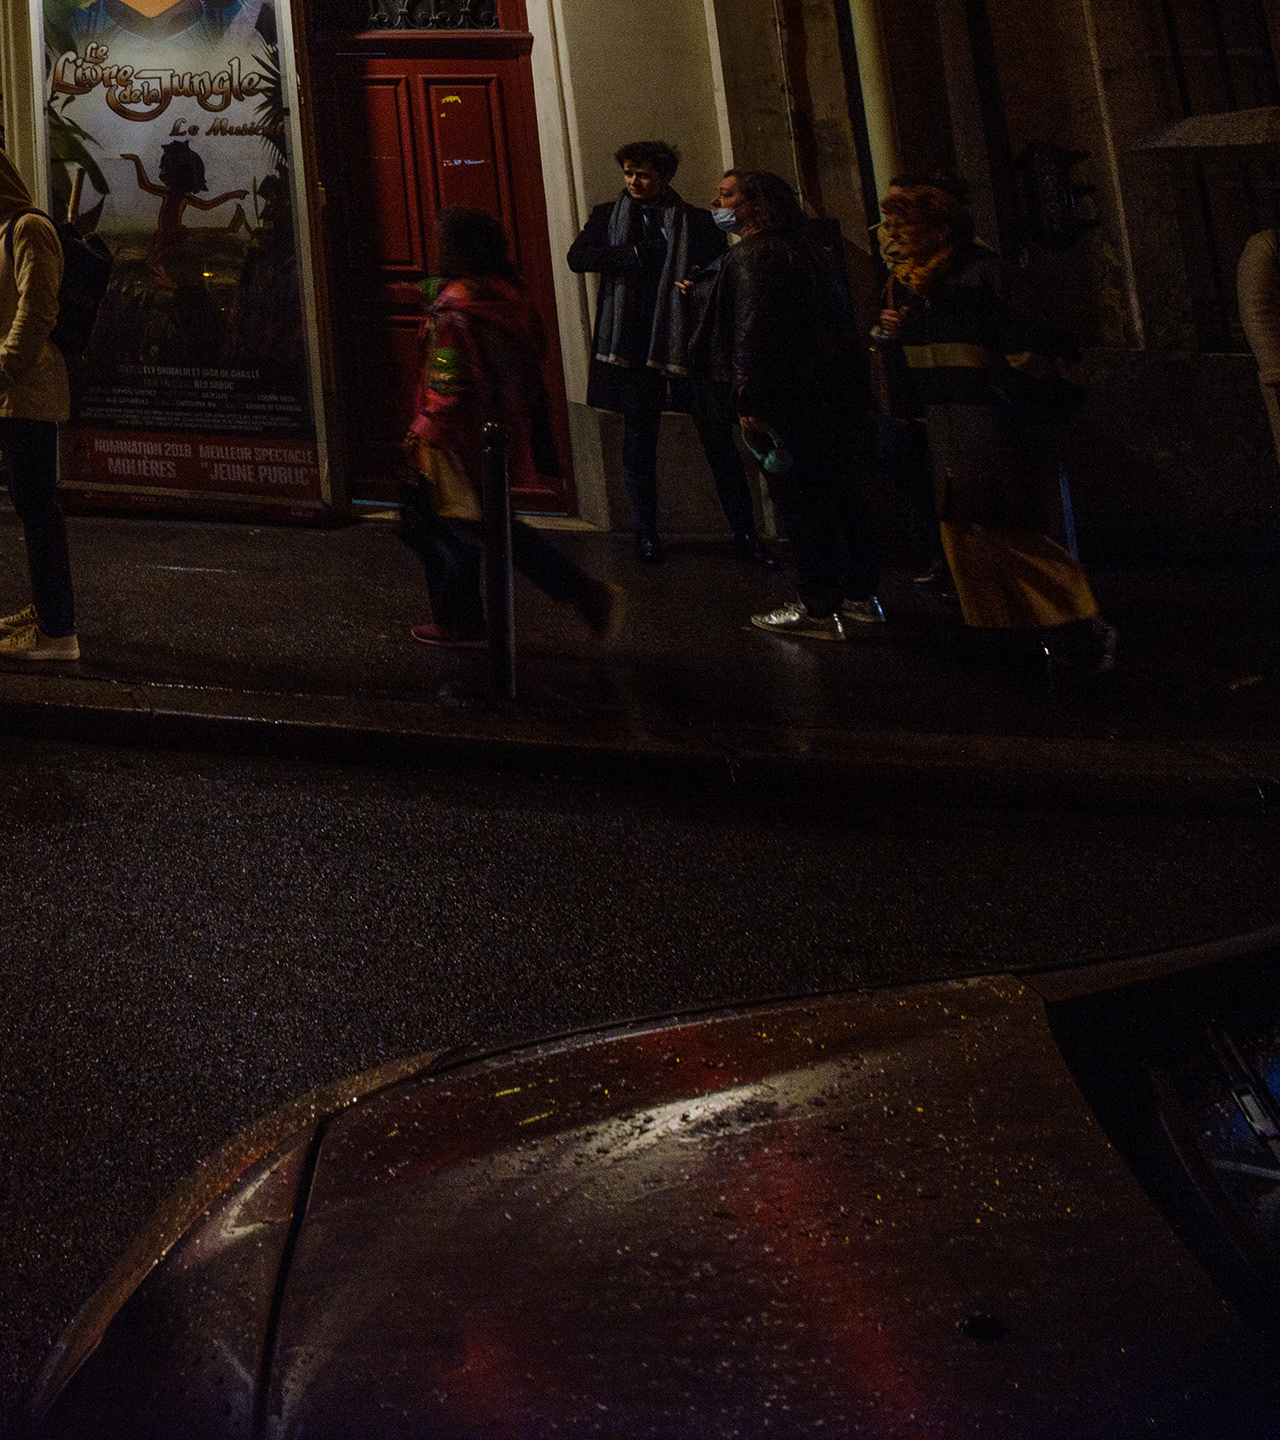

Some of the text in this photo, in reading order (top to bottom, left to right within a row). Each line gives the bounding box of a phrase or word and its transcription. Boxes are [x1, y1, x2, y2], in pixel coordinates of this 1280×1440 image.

[85, 41, 109, 64] Le
[52, 50, 134, 94] Livre
[106, 56, 262, 122] Jungle
[169, 117, 200, 136] Le
[94, 439, 162, 457] NOMINATION
[199, 443, 252, 461] MEILLEUR
[253, 447, 314, 465] SPECTACLE
